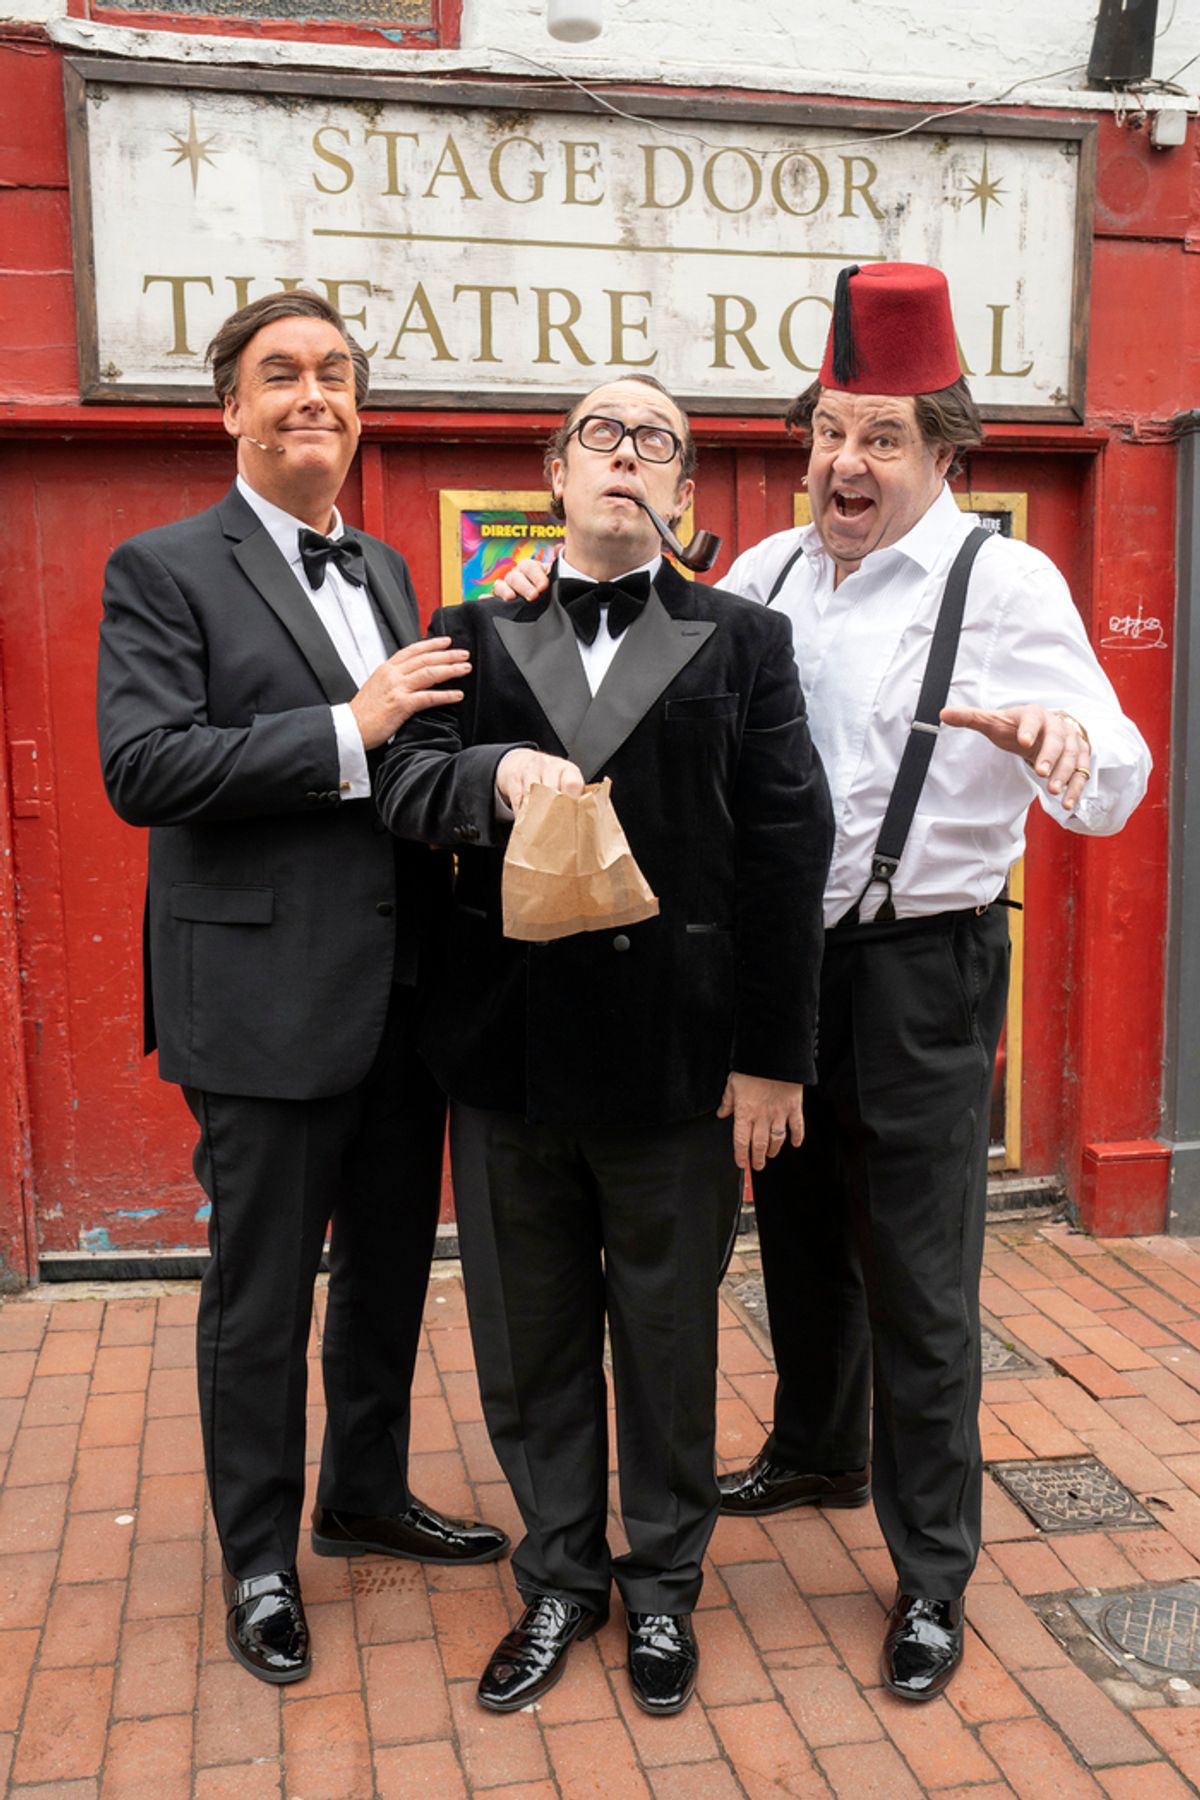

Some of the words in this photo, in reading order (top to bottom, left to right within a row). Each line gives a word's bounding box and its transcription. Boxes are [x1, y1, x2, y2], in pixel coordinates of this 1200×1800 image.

[311, 125, 605, 207] STAGE
[638, 143, 885, 220] DOOR
[707, 292, 1034, 378] ROL
[481, 524, 528, 538] DIRECT
[530, 524, 567, 538] FROM
